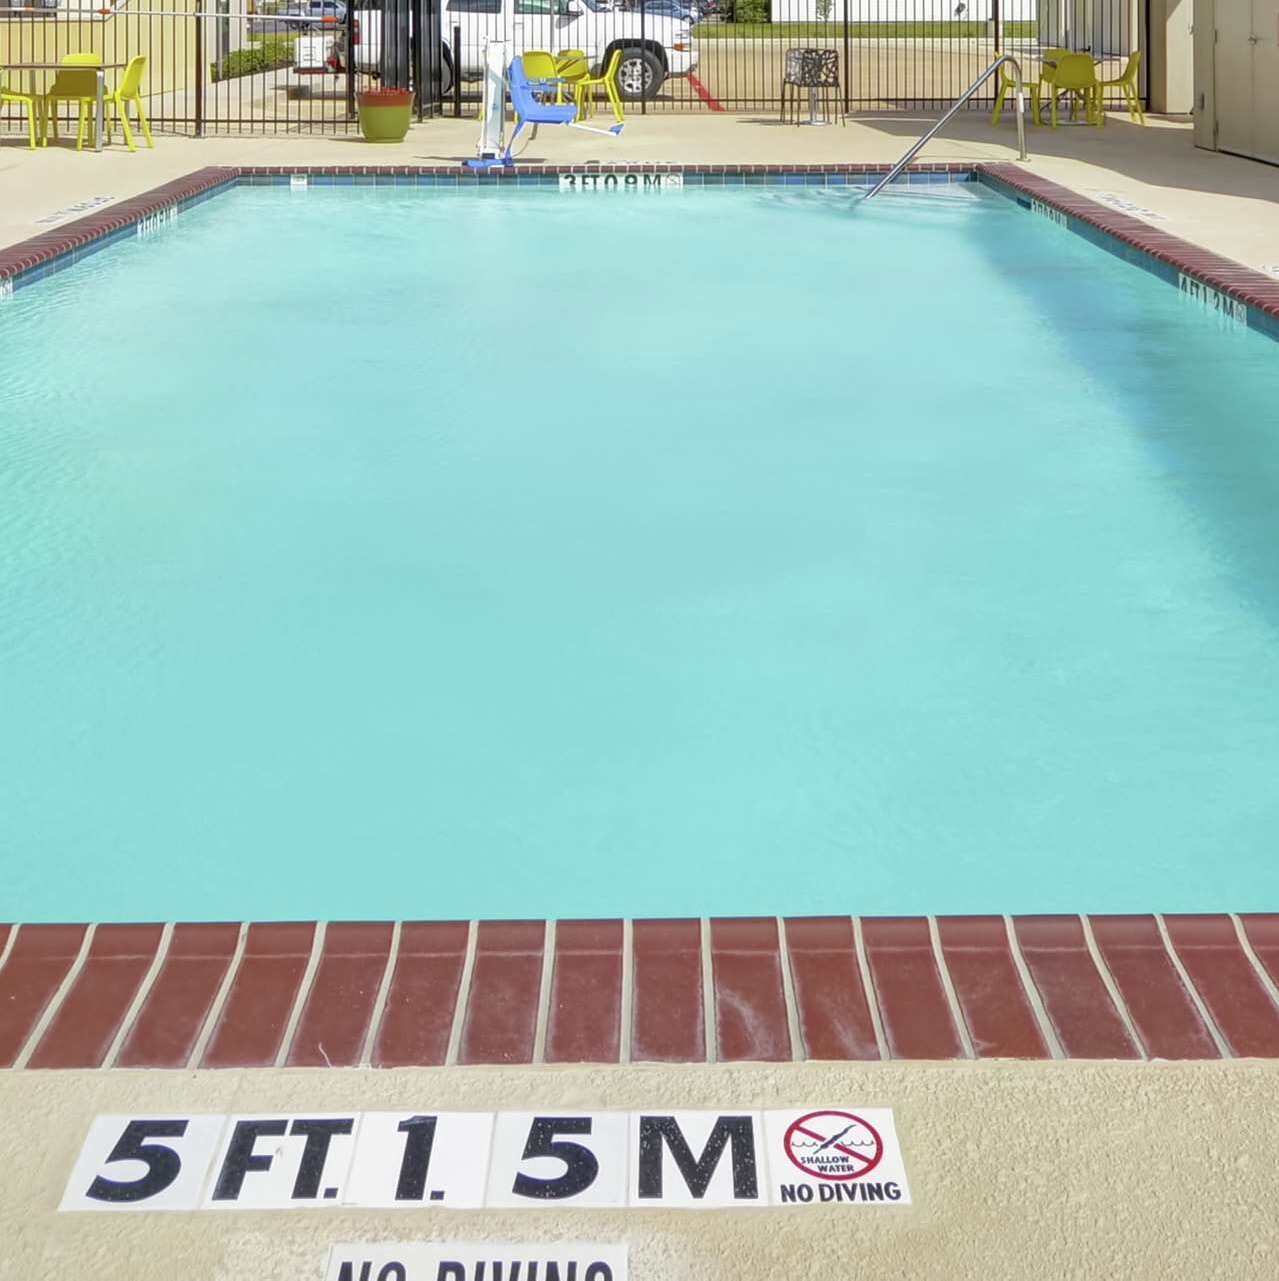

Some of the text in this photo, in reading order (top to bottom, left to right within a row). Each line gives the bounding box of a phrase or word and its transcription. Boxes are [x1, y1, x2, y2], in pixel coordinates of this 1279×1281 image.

[85, 1119, 189, 1203] 5
[211, 1118, 354, 1201] FT.
[638, 1115, 758, 1198] M
[800, 1155, 850, 1165] SHALLOW
[817, 1164, 855, 1173] WATER
[780, 1181, 902, 1203] NO DIVING
